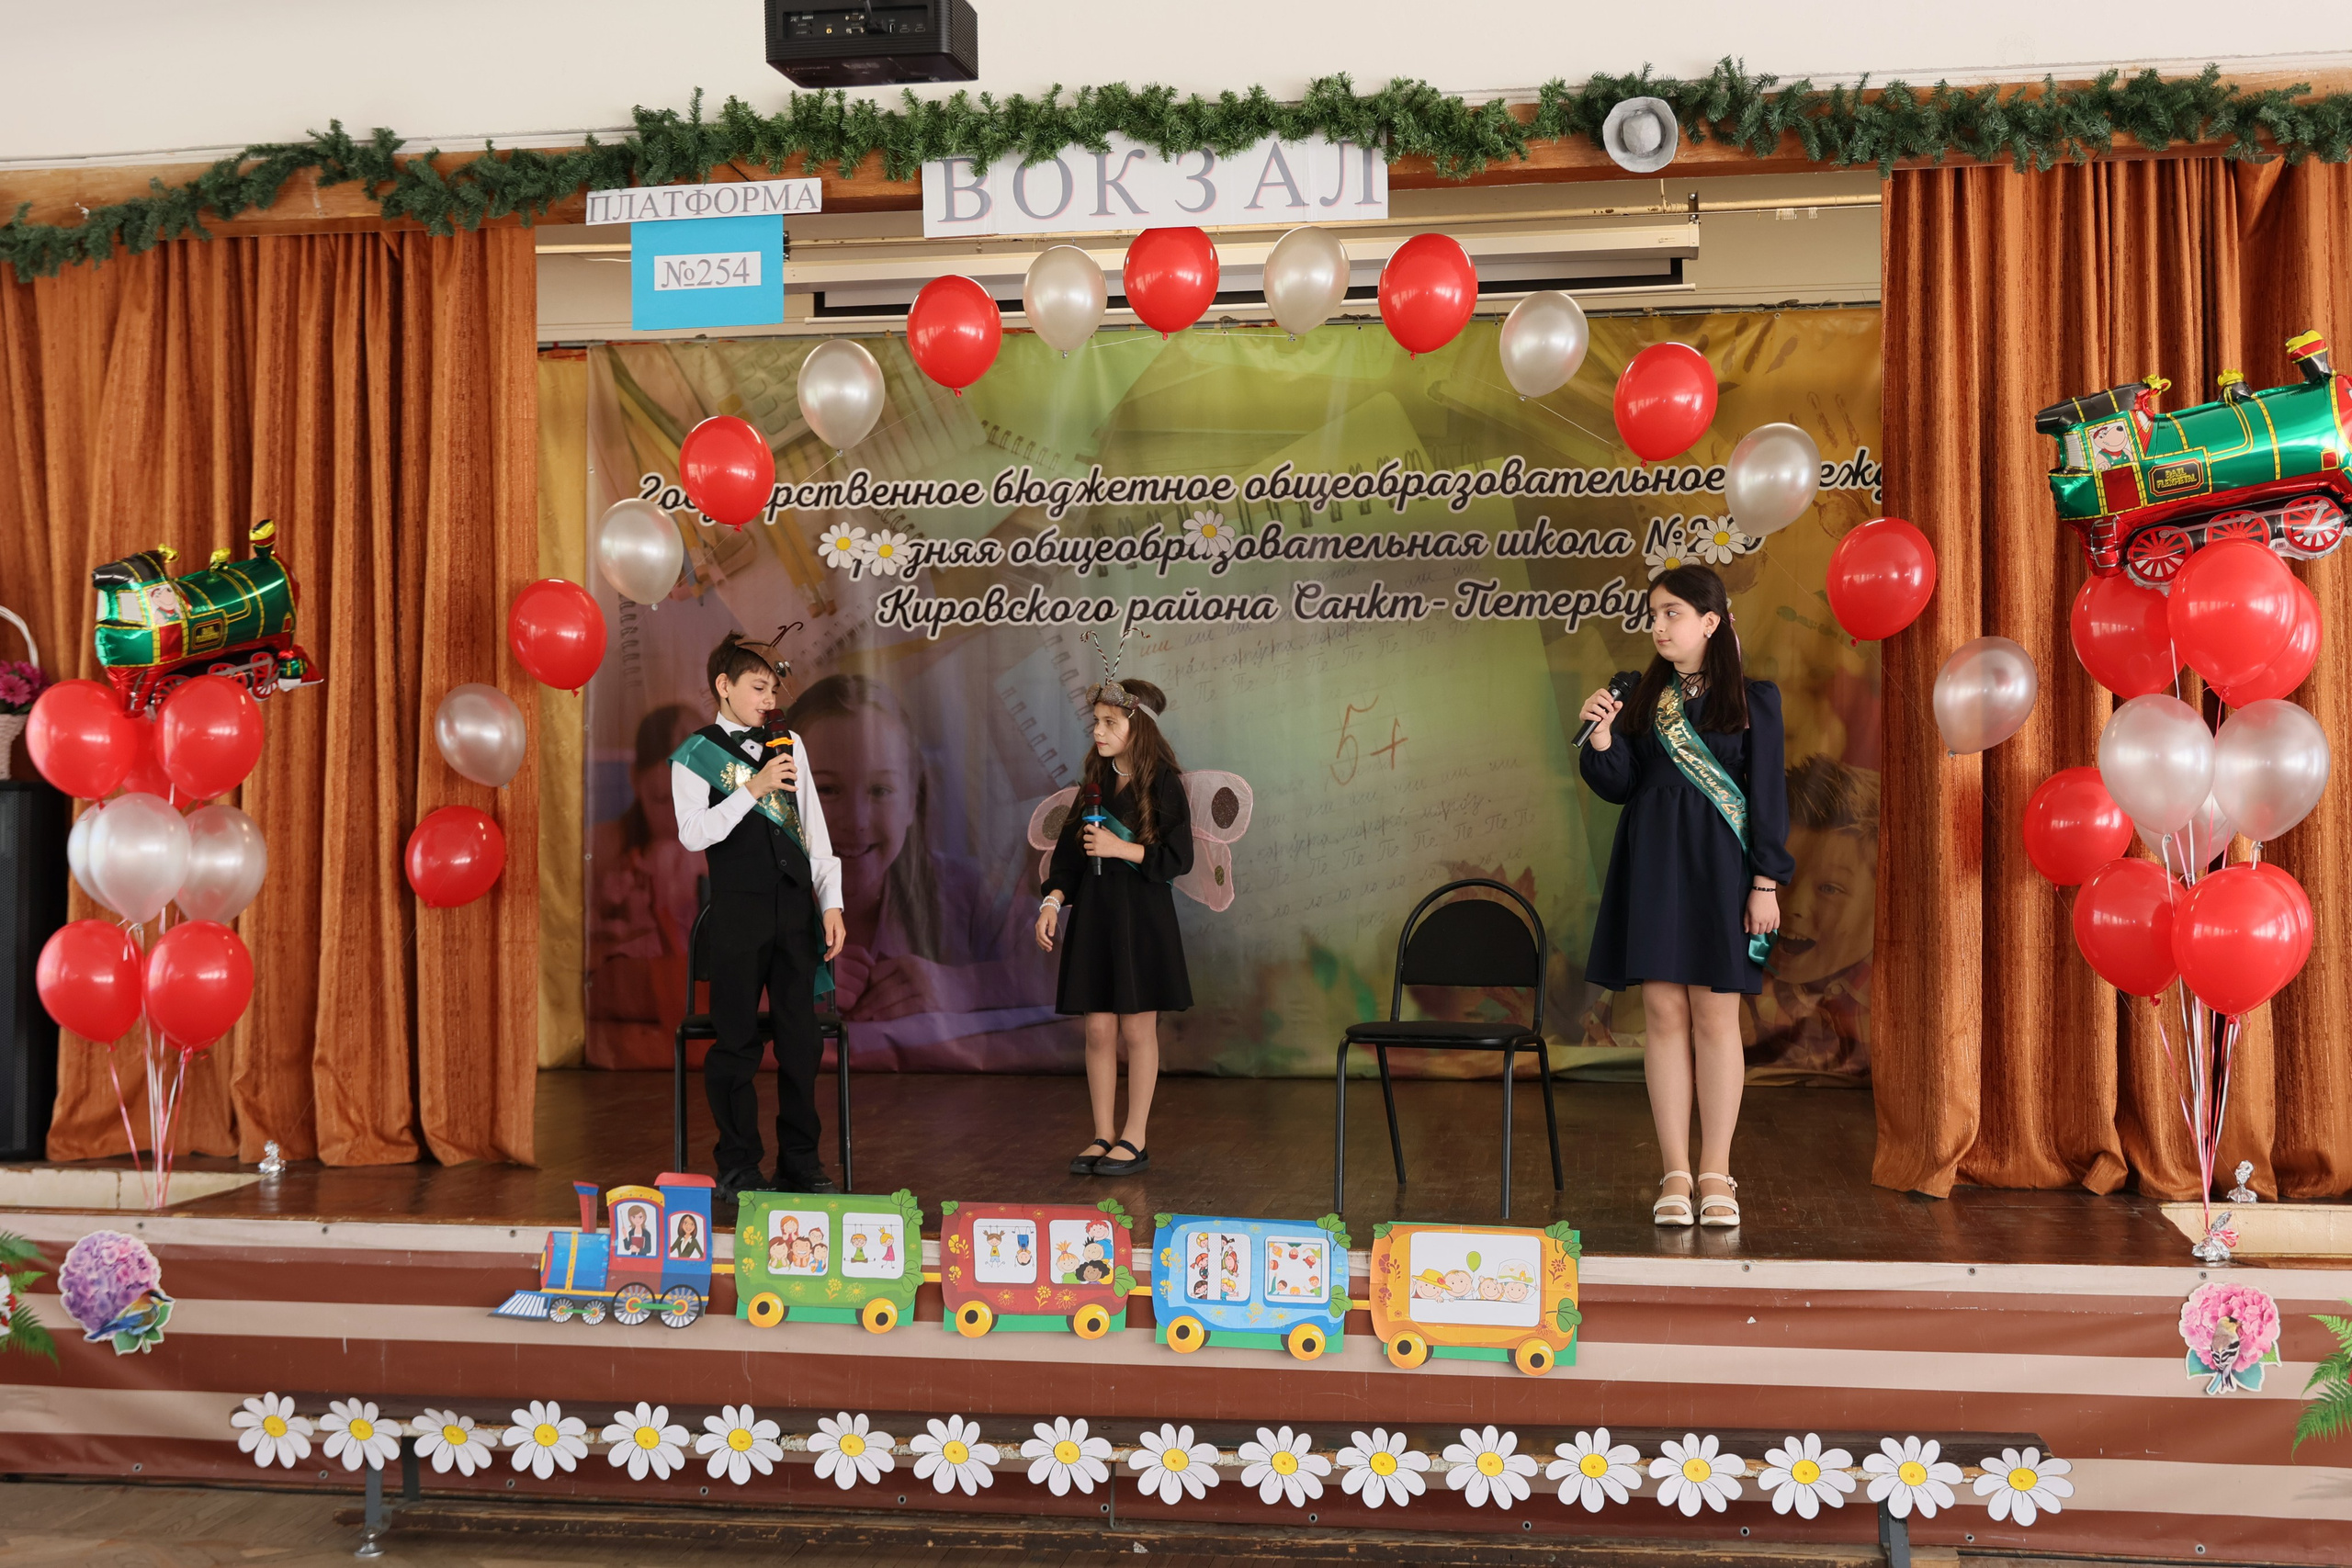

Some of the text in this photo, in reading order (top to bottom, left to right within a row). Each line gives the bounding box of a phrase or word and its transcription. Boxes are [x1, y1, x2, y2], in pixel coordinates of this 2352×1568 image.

[589, 182, 819, 222] ПЛАТФОРМА
[937, 141, 1383, 223] ВОКЗАЛ
[661, 256, 750, 288] №254
[994, 467, 1233, 517] бюджетное
[1245, 458, 1724, 512] общеобразовательное
[1498, 517, 1634, 556] школа
[879, 587, 1118, 637] Кировского
[1124, 590, 1276, 636] района
